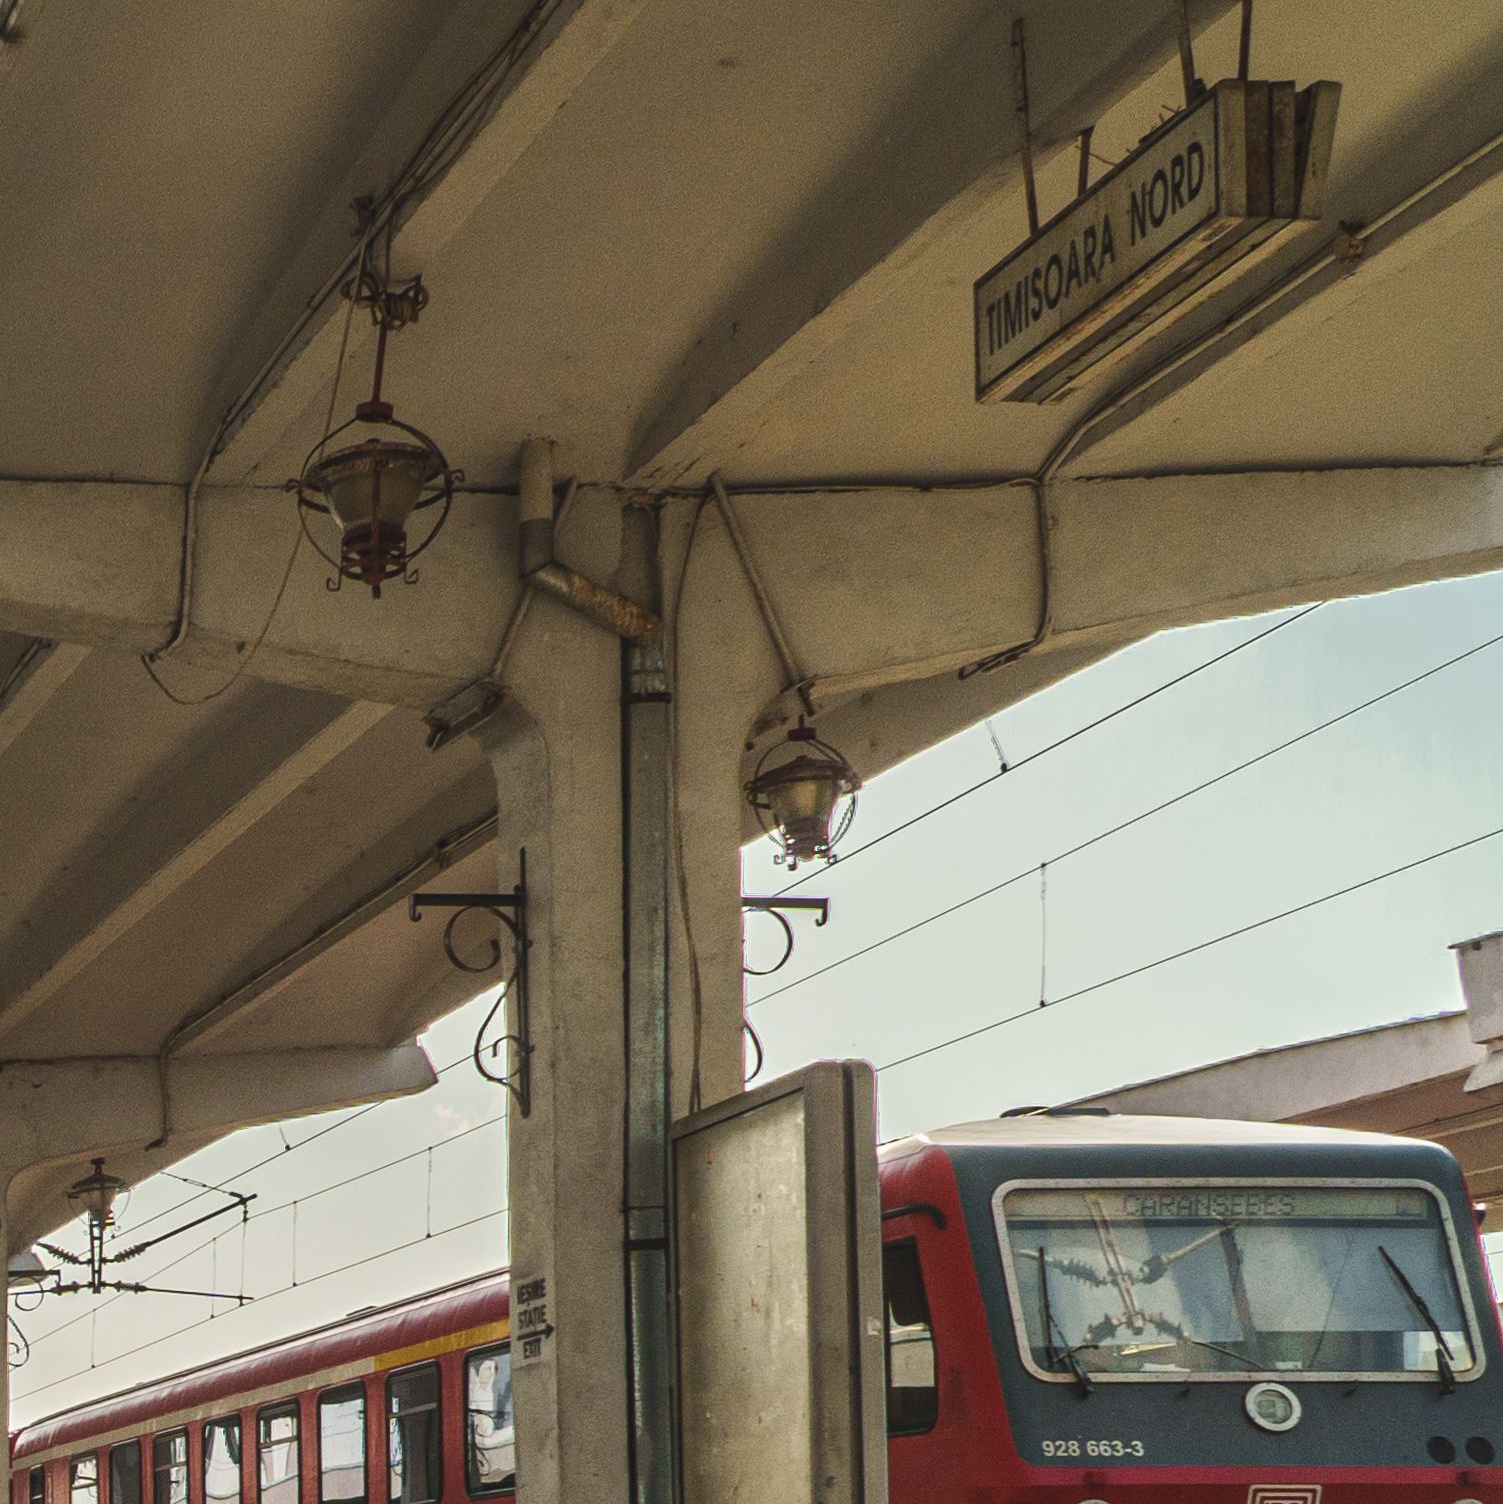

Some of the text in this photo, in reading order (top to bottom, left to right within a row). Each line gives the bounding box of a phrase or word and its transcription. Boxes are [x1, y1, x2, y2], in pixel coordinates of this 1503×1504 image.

[986, 142, 1205, 356] TIMISOARA NORD
[1042, 1440, 1145, 1457] 928 663-3
